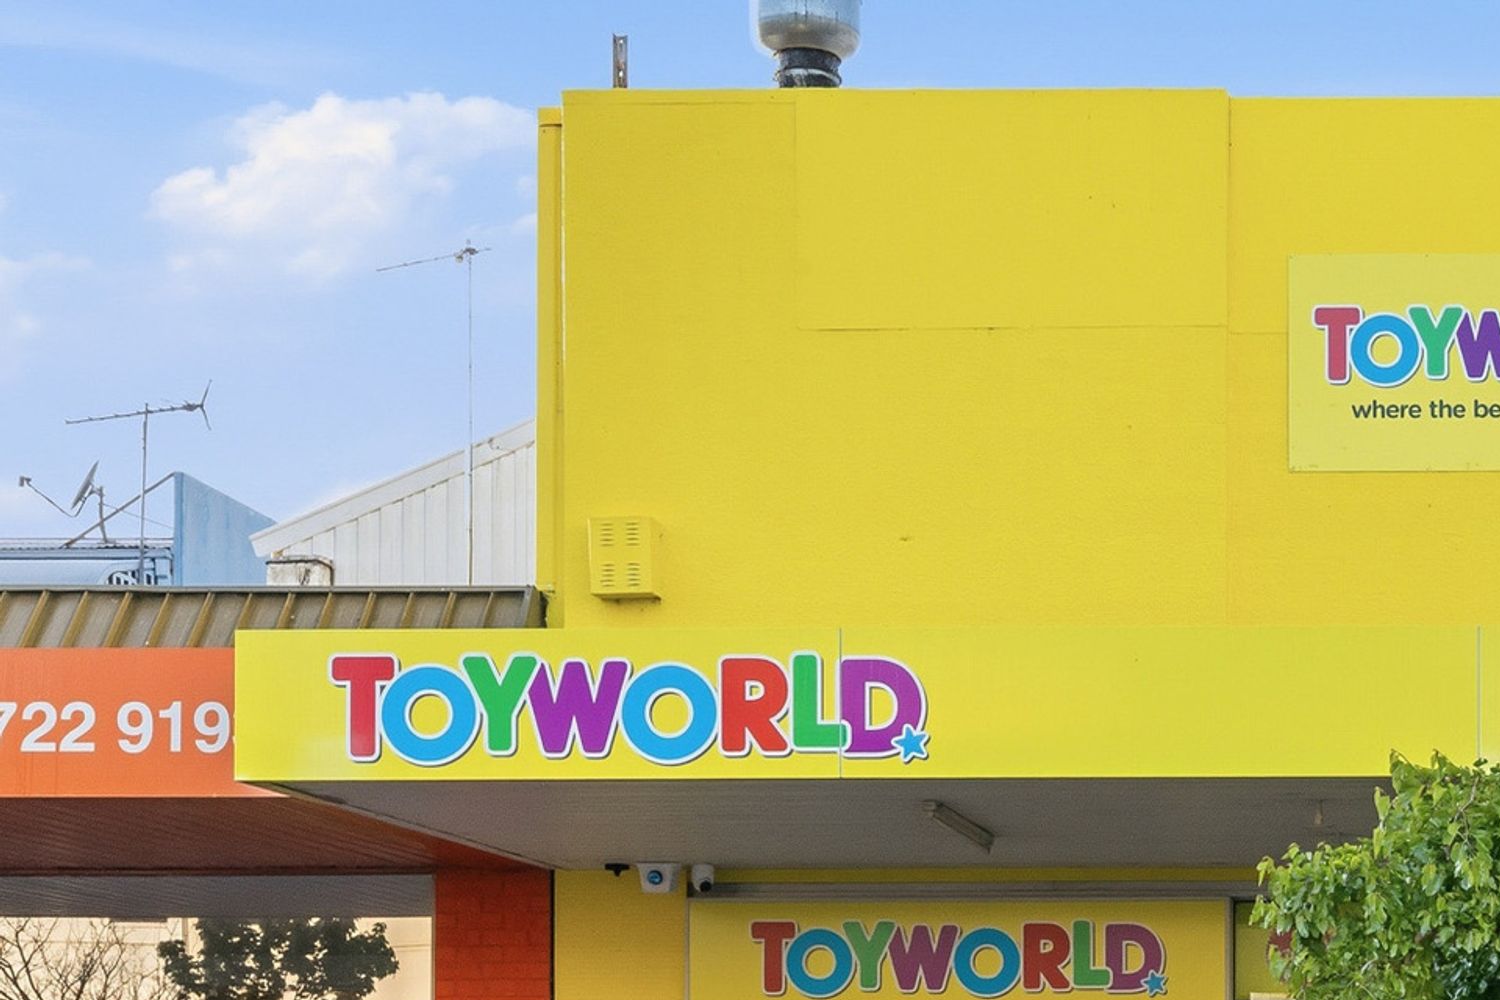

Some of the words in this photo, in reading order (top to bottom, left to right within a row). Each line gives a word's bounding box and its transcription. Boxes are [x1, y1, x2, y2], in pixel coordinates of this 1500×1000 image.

[1351, 399, 1421, 418] where
[1429, 399, 1466, 418] the
[116, 700, 236, 753] 919
[330, 652, 928, 767] TOYWORLD
[750, 920, 1168, 998] TOYWORLD
